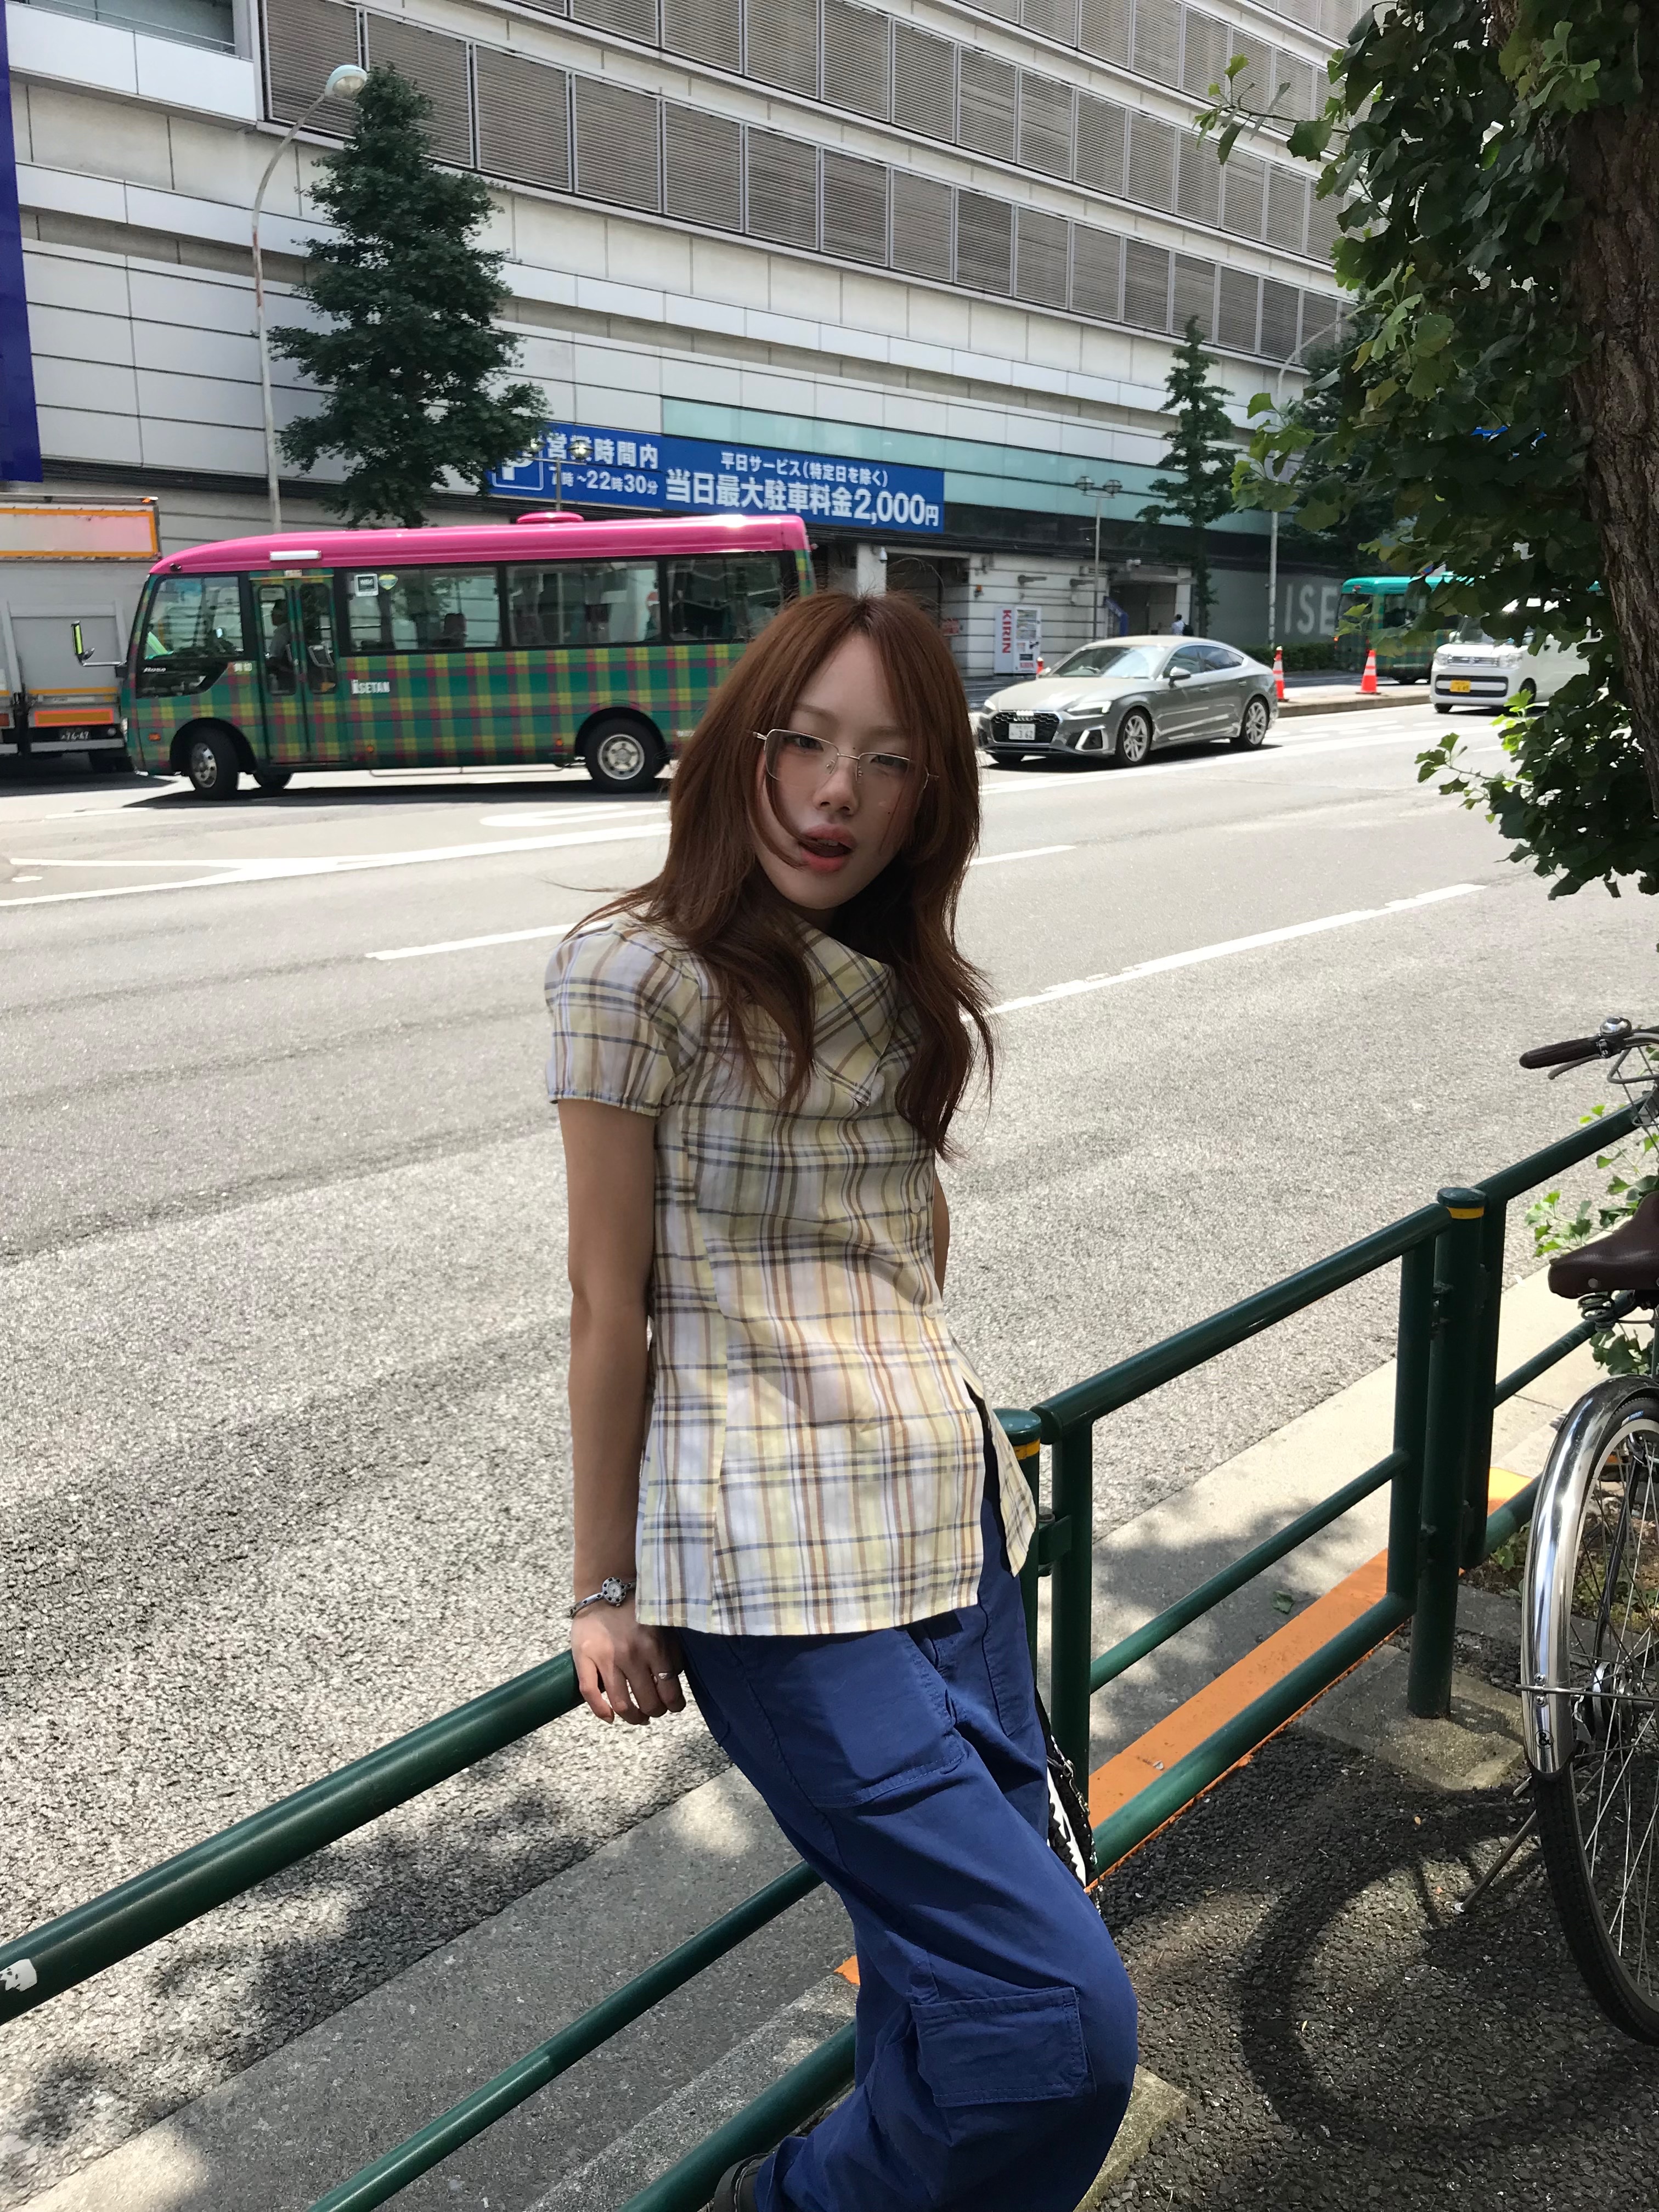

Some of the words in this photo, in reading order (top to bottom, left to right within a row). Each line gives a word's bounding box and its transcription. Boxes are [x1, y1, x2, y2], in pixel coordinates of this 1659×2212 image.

[720, 450, 888, 488] 平日サービス(特定日を除く)
[665, 469, 939, 527] 当日最大駐車料金2,000円
[1002, 610, 1012, 653] KIRIN
